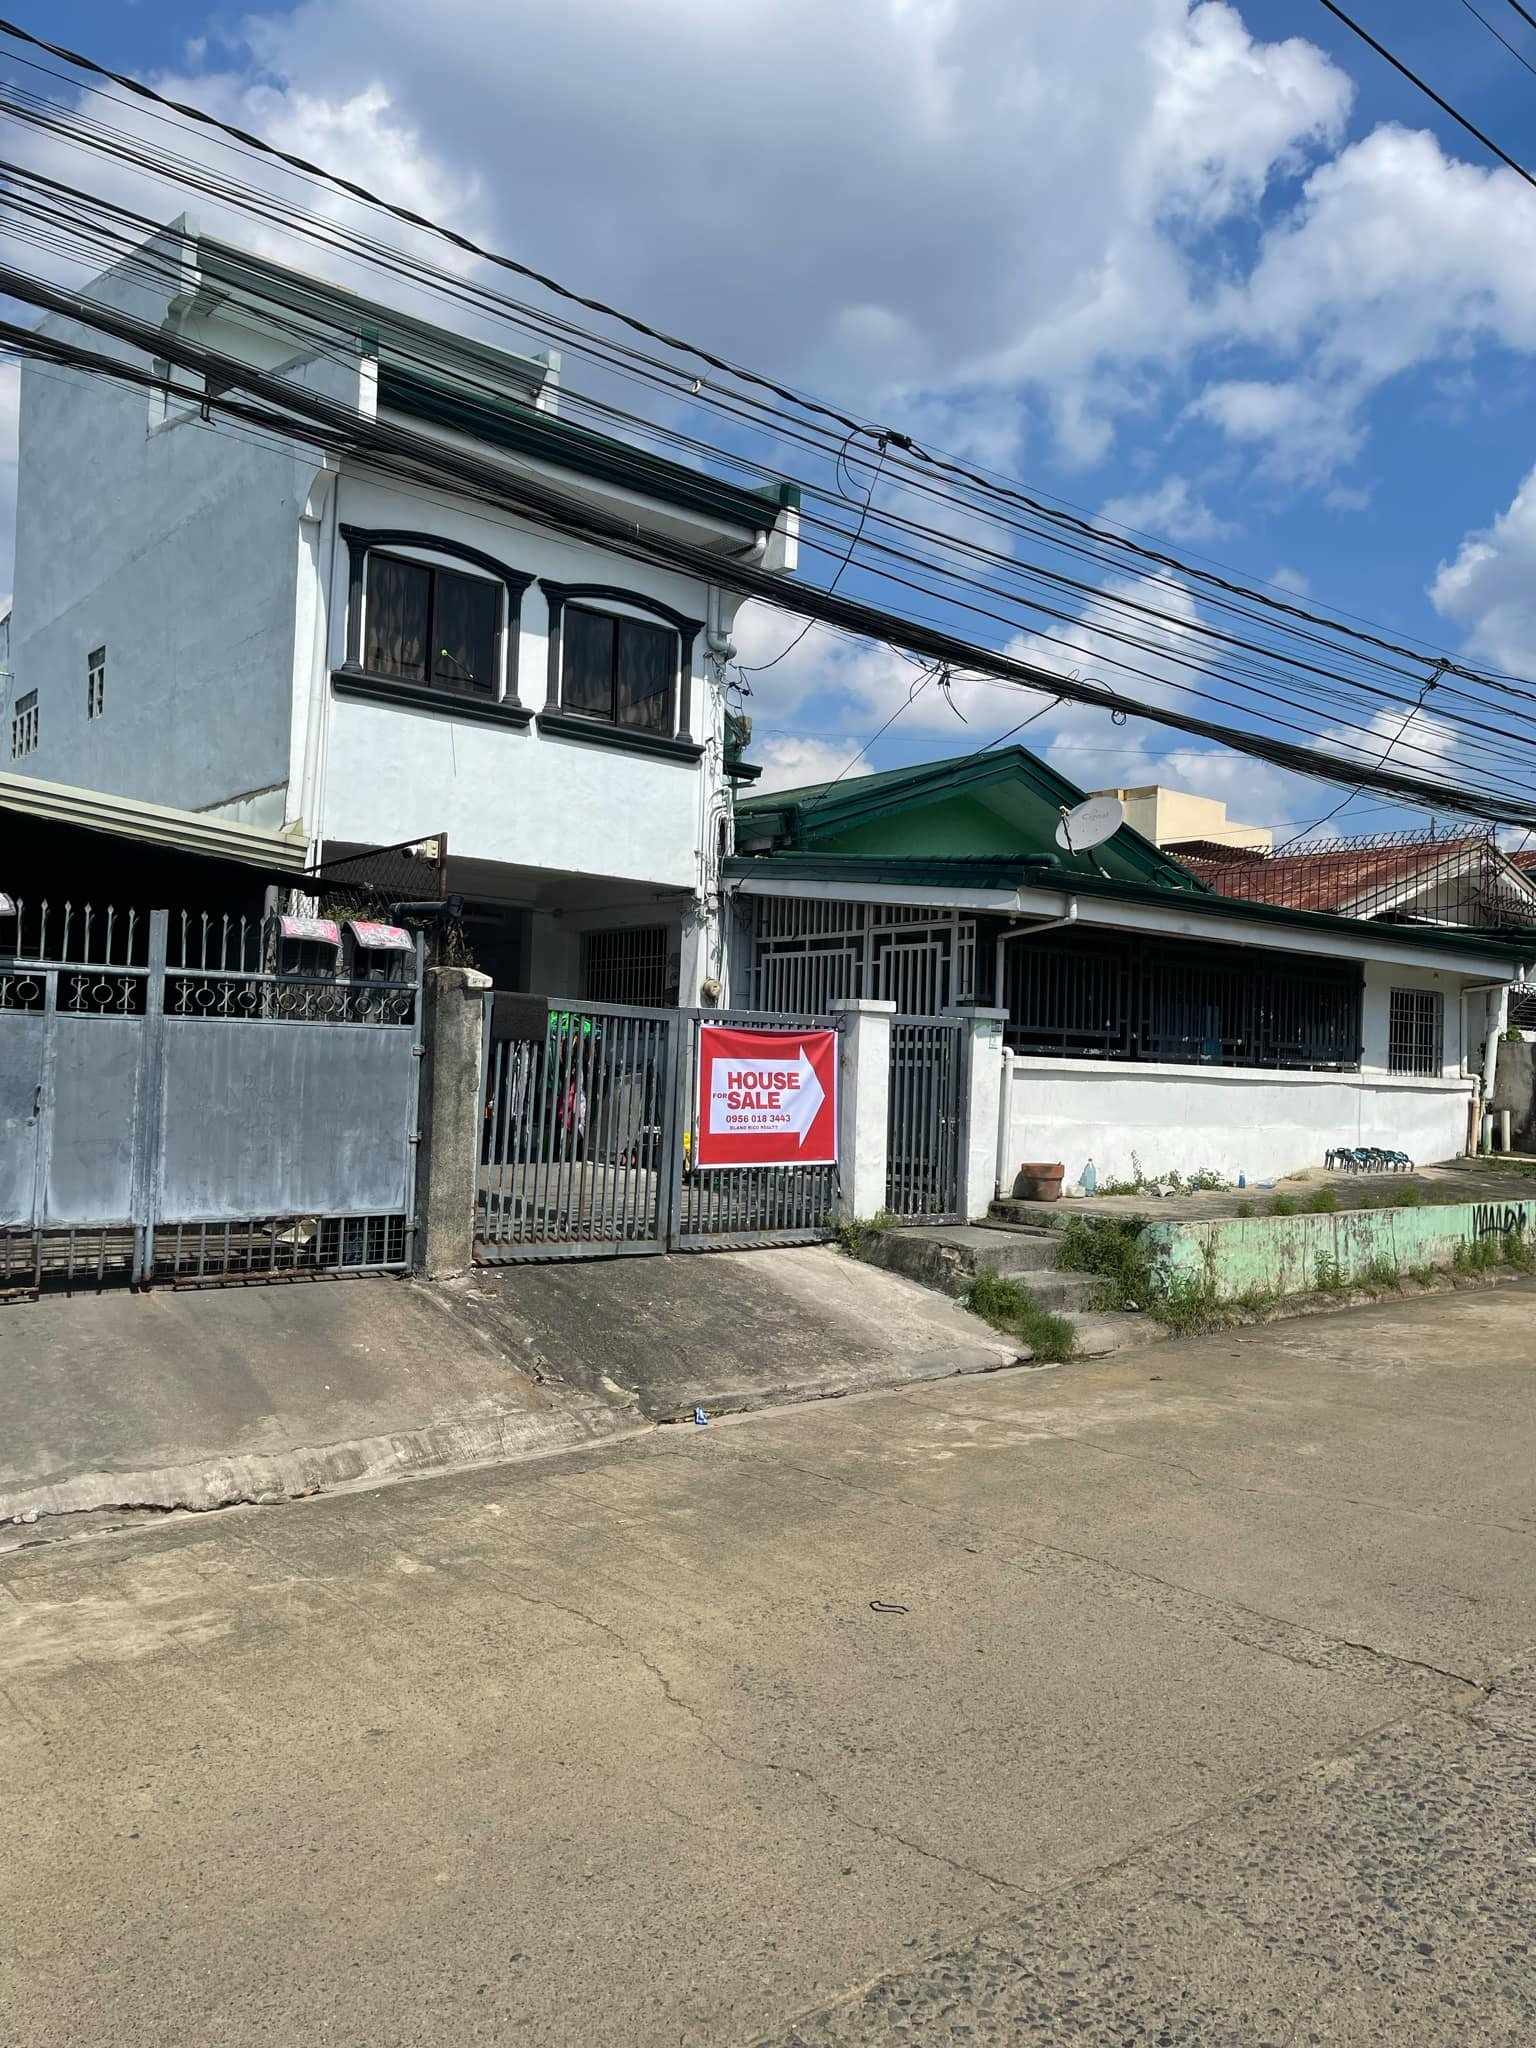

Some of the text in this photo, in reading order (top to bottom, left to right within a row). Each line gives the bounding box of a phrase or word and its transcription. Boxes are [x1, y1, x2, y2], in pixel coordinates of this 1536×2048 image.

[727, 1072, 800, 1090] HOUSE
[727, 1092, 781, 1109] SALE
[726, 1114, 791, 1123] 0956 018 3443
